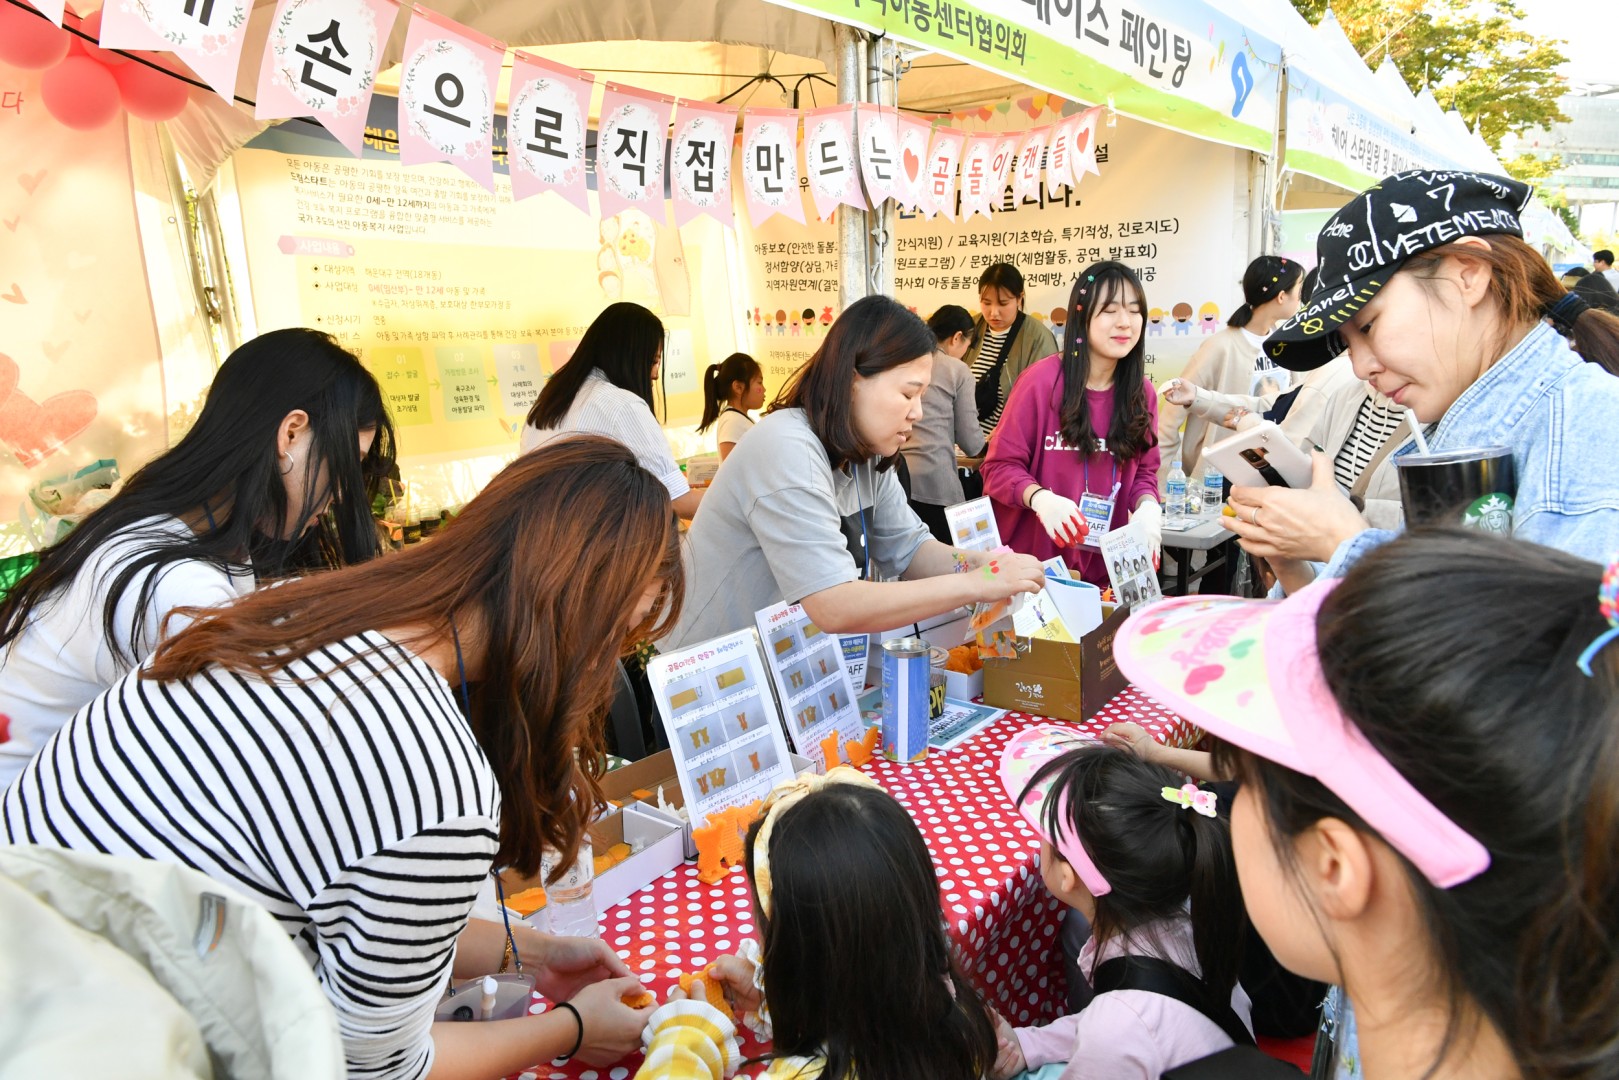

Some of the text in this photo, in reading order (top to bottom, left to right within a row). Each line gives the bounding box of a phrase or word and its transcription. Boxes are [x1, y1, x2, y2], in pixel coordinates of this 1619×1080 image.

[853, 0, 1028, 66] 아동센터협의회
[1119, 8, 1192, 88] 페인팅
[303, 161, 330, 173] 아동은
[334, 164, 359, 177] 공평한
[290, 171, 337, 188] 드림스타트는
[340, 179, 365, 191] 아동의
[368, 182, 391, 193] 공평한
[298, 212, 314, 225] 국가
[352, 220, 385, 232] 아동복지
[1322, 216, 1354, 238] Acne
[897, 235, 943, 252] 간식지원)
[957, 229, 1057, 248] 교육지원(기초학습,
[1061, 223, 1113, 241] 특기적성,
[1117, 217, 1180, 238] 진로지도)
[754, 241, 815, 256] 아동보호(안전한
[894, 255, 956, 271] 원프로그램)
[1109, 243, 1157, 262] 발표회)
[1086, 521, 1106, 532] TAFF
